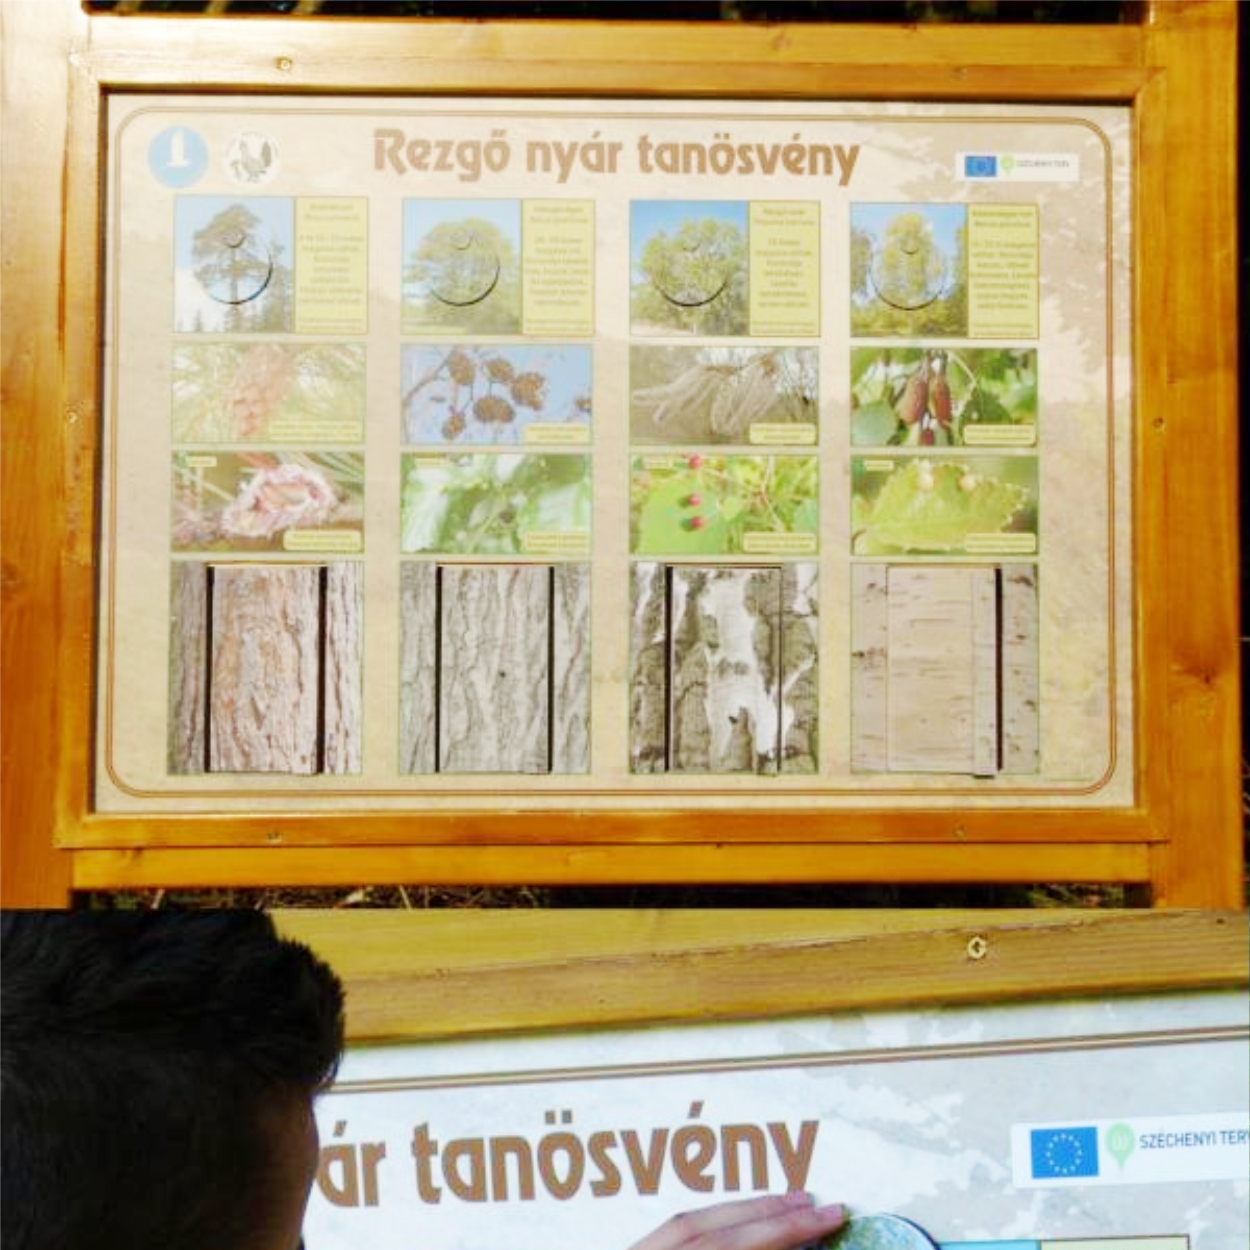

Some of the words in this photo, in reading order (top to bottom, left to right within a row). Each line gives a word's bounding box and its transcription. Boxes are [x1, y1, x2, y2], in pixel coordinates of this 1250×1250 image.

[373, 127, 512, 183] Rezgő
[525, 130, 622, 184] nyár
[637, 132, 861, 186] tanösvény
[315, 1120, 387, 1208] ár
[411, 1100, 820, 1205] tanösvény
[1139, 1128, 1217, 1149] SZÉCHENYI
